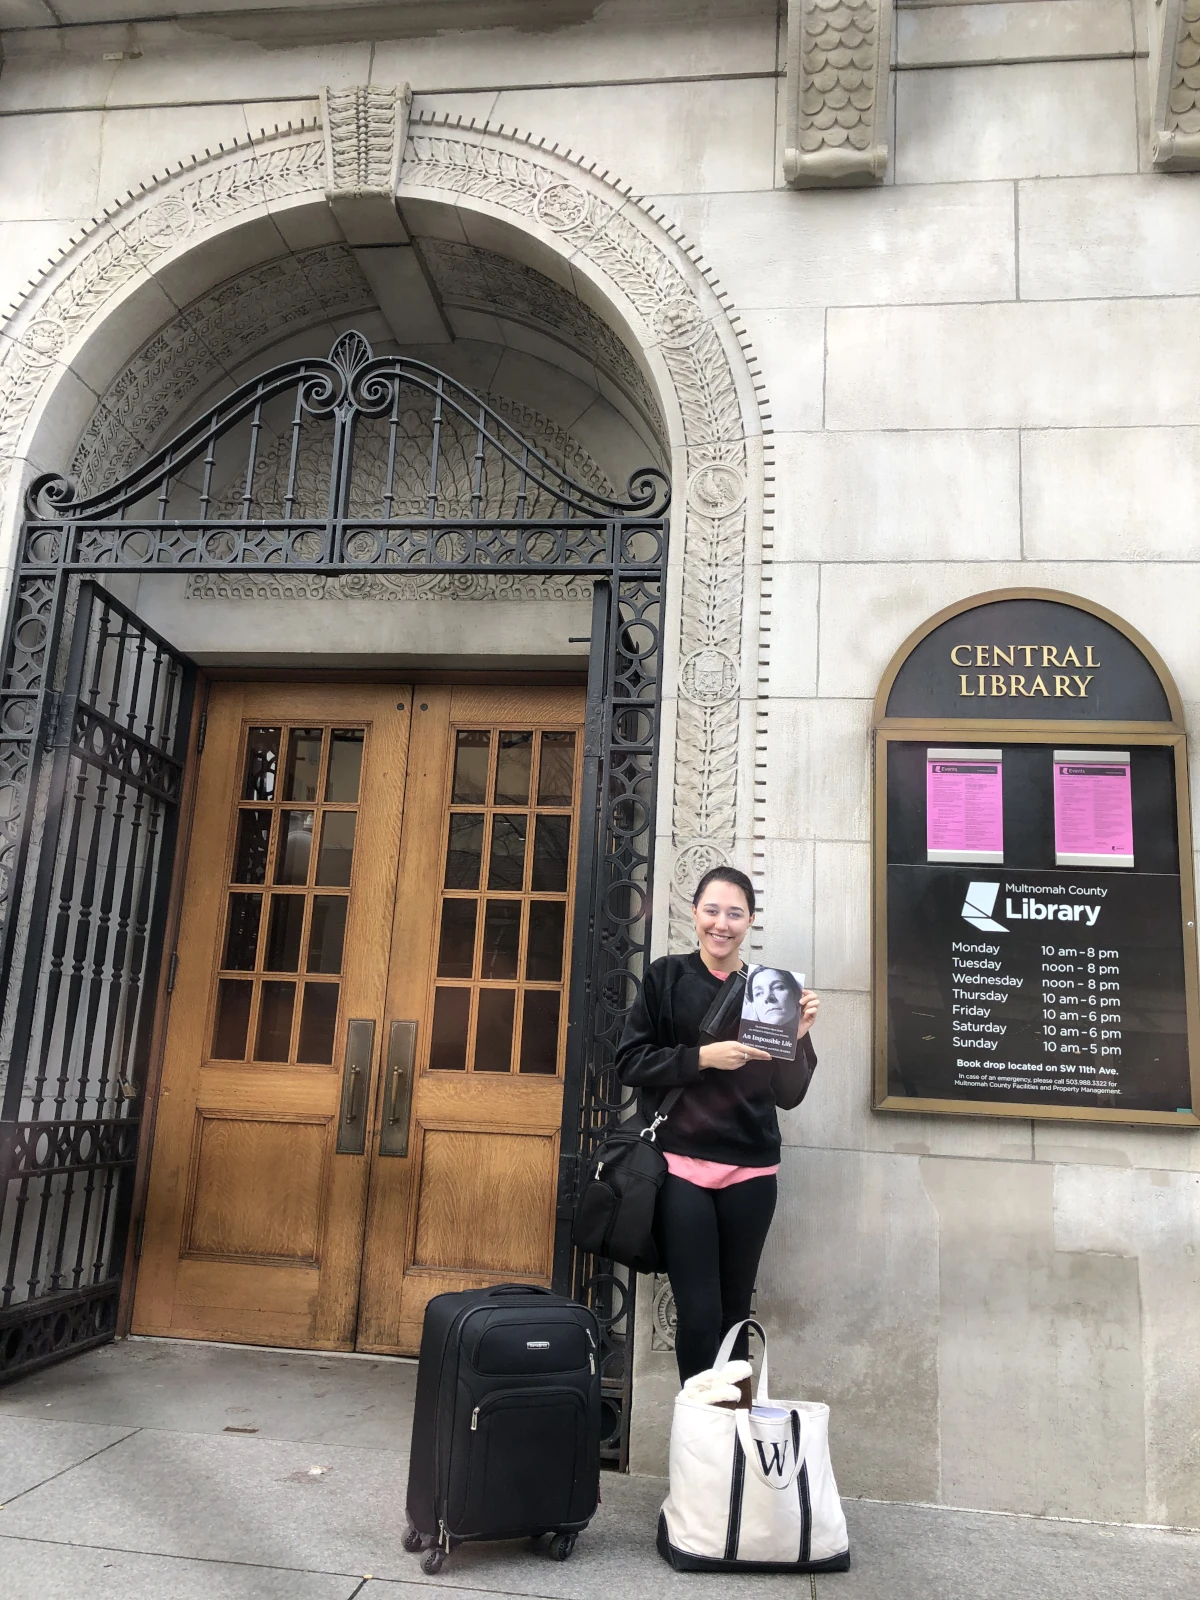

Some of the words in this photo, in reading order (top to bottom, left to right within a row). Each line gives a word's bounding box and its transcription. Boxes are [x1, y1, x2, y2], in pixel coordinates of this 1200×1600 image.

[950, 644, 1101, 668] CENTRAL
[958, 674, 1094, 698] LIBRARY
[1005, 883, 1066, 895] Multnomah
[1069, 885, 1108, 897] County
[1005, 897, 1101, 926] Library
[952, 942, 1000, 955] Monday
[1041, 946, 1055, 956] 10
[1098, 949, 1119, 960] pm
[952, 957, 1002, 971] Tuesday
[1041, 963, 1074, 973] noon
[1087, 963, 1096, 974] 8
[1099, 965, 1120, 976] pm
[952, 973, 1024, 988] Wednesday
[1042, 979, 1075, 989] noon
[1088, 979, 1096, 990] 8
[1099, 981, 1120, 992] pm
[952, 988, 1008, 1003] Thursday
[1042, 993, 1056, 1004] 10
[1100, 997, 1121, 1008] pm
[952, 1004, 991, 1018] Friday
[1042, 1009, 1056, 1020] 10
[1100, 1013, 1121, 1024] pm
[752, 1034, 780, 1045] Impossible
[952, 1020, 1008, 1035] Saturday
[1042, 1025, 1057, 1036] 10
[1101, 1029, 1122, 1040] pm
[952, 1036, 999, 1050] Sunday
[1043, 1041, 1057, 1052] 10
[1101, 1045, 1122, 1056] pm
[956, 1058, 981, 1068] Book
[983, 1060, 1006, 1070] drop
[1008, 1061, 1043, 1071] located
[1060, 1064, 1076, 1073] SW
[1078, 1065, 1096, 1074] 11th
[1098, 1066, 1119, 1075] Ave.
[954, 1079, 988, 1088] Multnomah
[989, 1081, 1012, 1089] County
[1012, 1082, 1039, 1090] Facilities
[1052, 1084, 1080, 1093] Property
[1080, 1086, 1123, 1095] Management.
[997, 1075, 1032, 1083] emergency,
[1065, 1078, 1107, 1087] 503.988.3322
[753, 1438, 788, 1476] W
